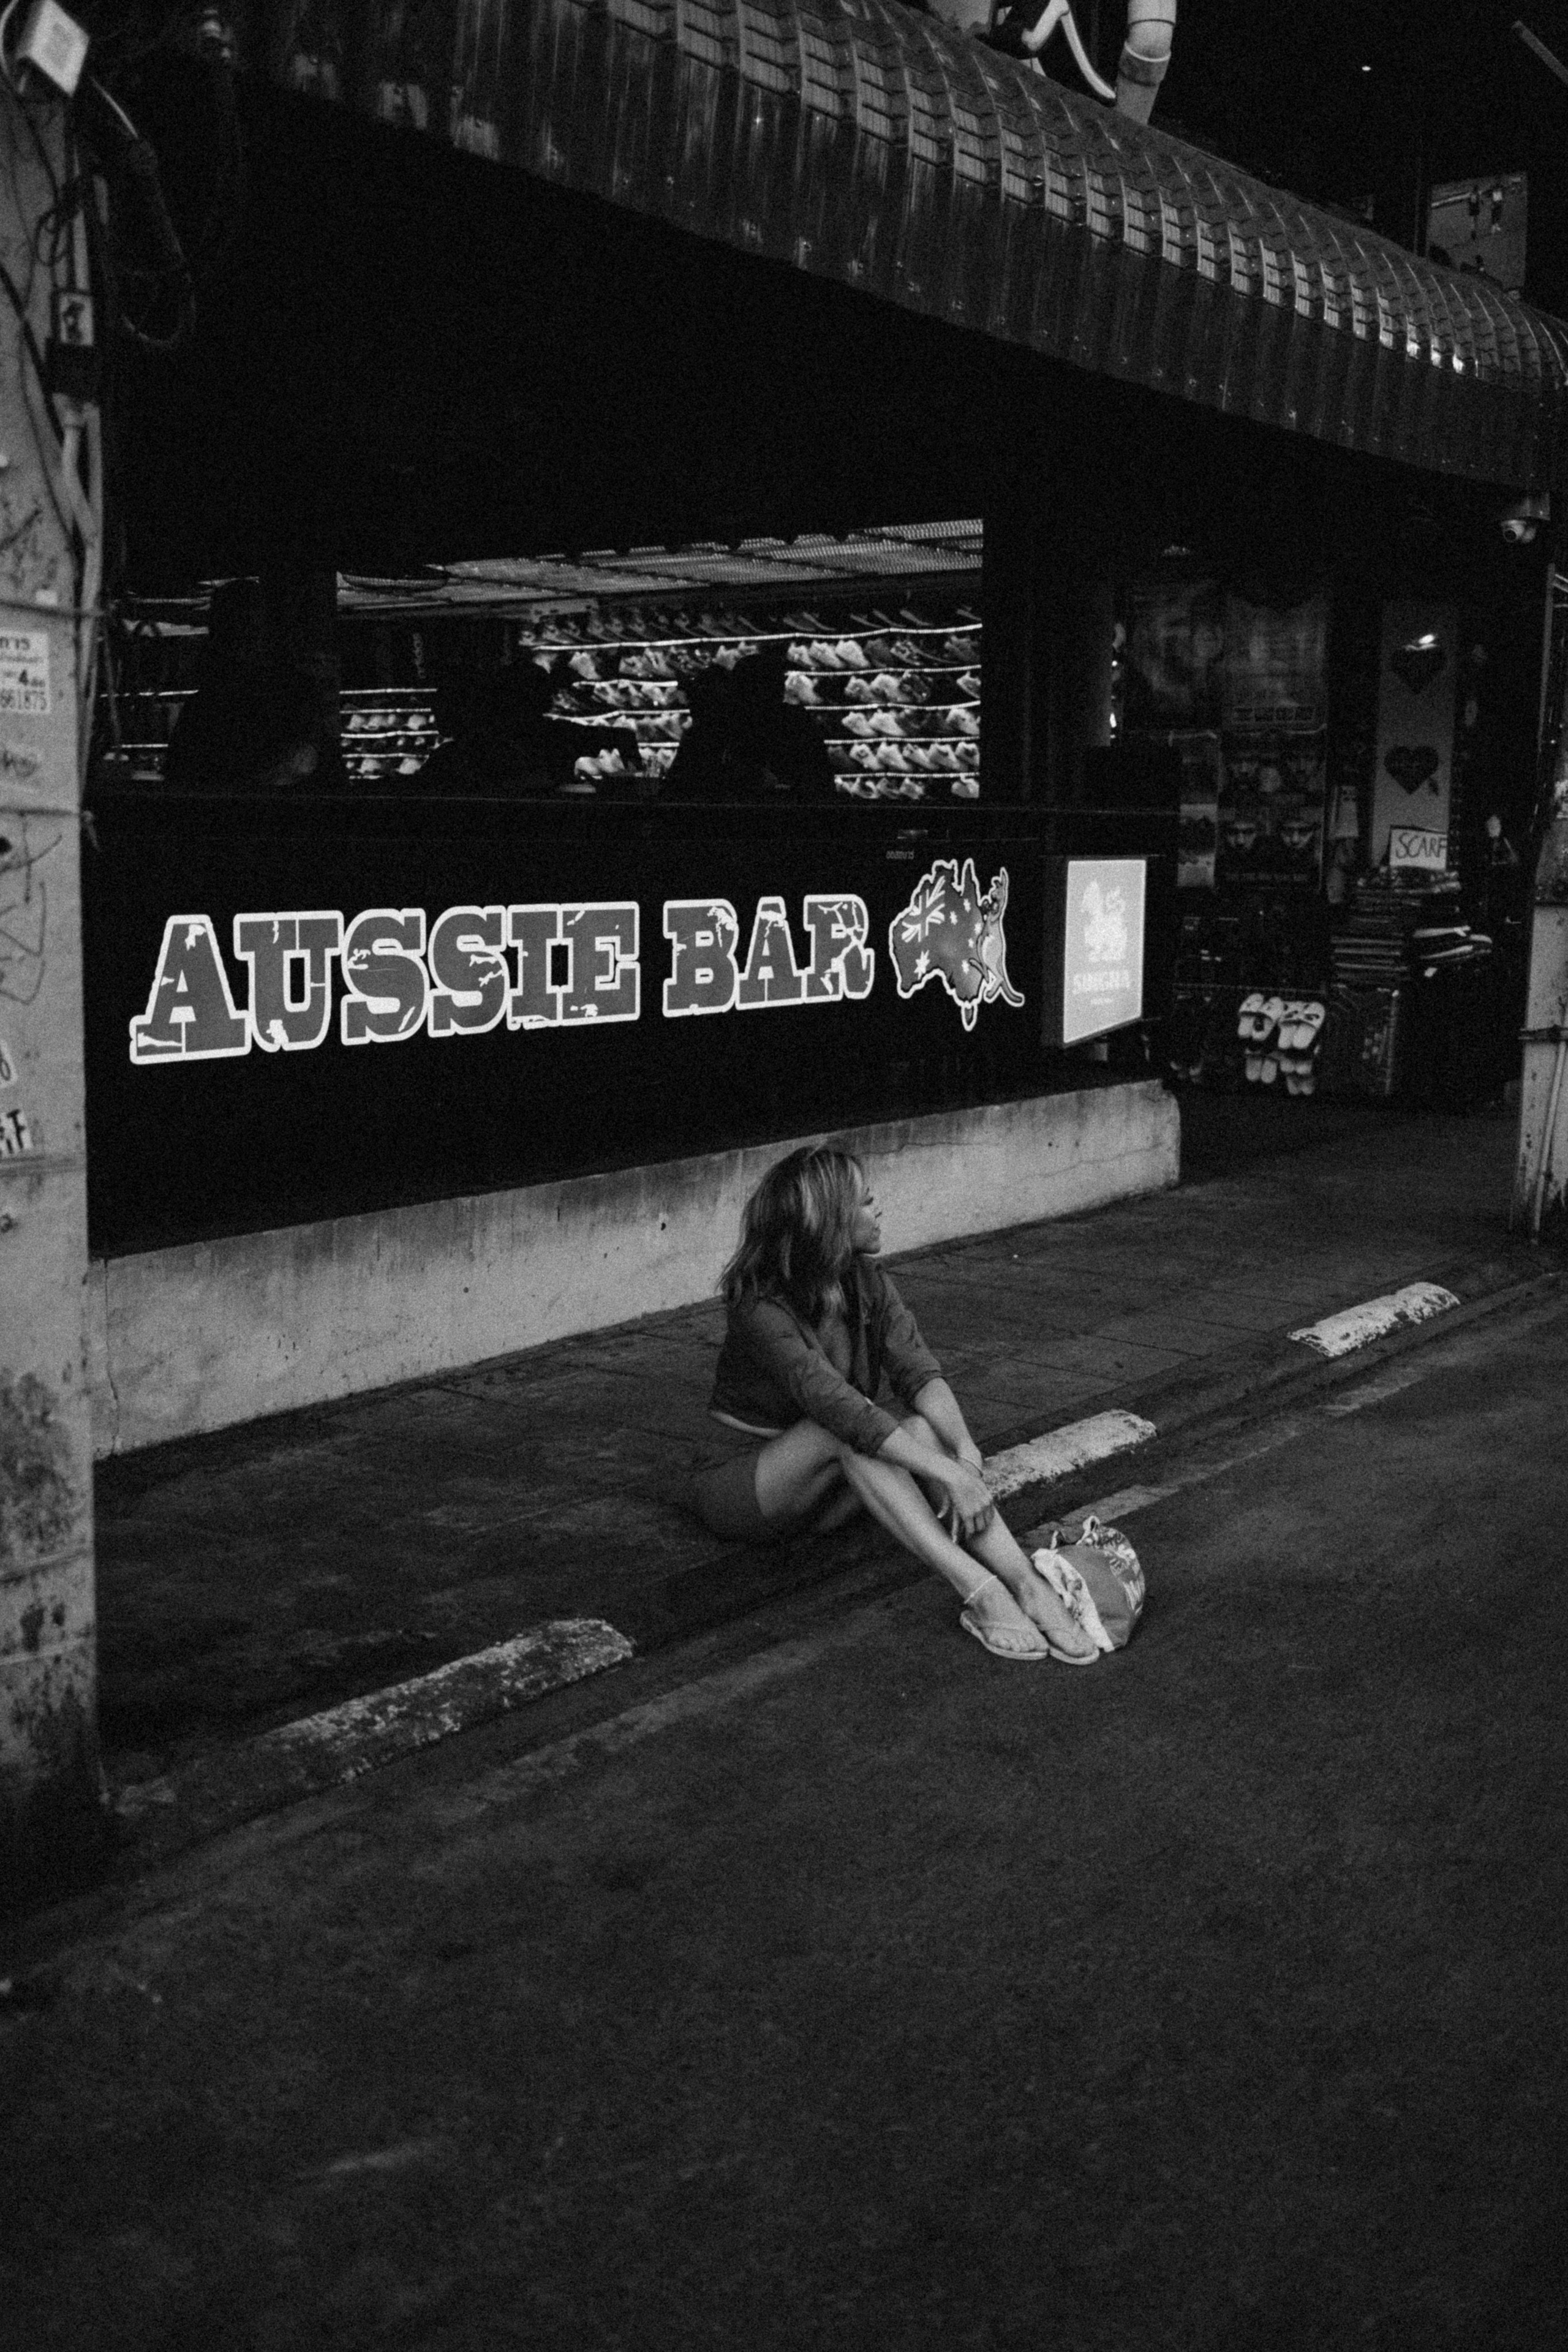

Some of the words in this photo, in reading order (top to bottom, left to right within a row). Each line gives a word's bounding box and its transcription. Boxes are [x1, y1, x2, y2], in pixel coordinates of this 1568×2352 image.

[1395, 832, 1448, 859] SCARF
[129, 901, 641, 1065] AUSSIE
[662, 894, 875, 1017] BAR
